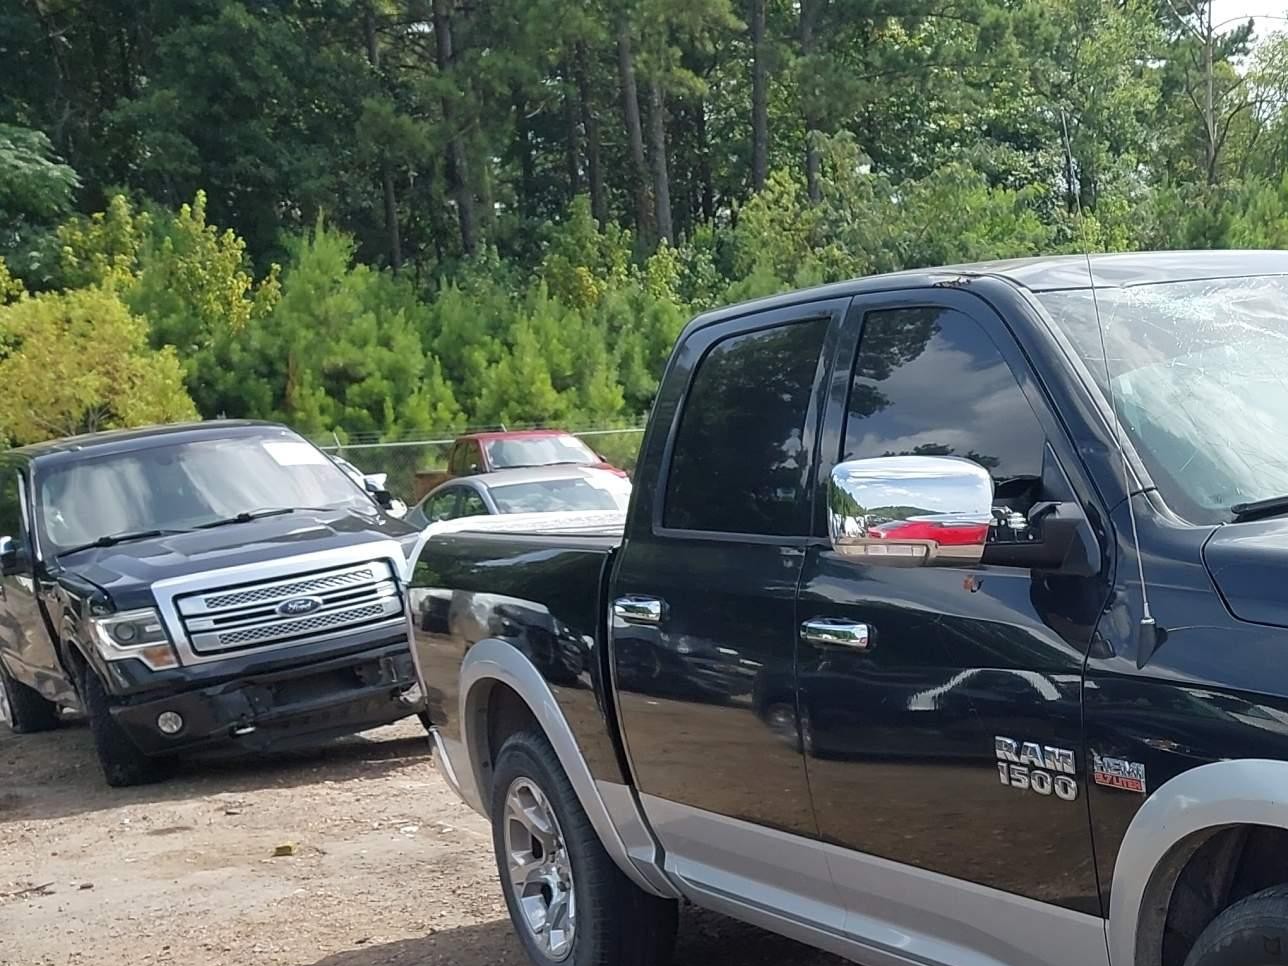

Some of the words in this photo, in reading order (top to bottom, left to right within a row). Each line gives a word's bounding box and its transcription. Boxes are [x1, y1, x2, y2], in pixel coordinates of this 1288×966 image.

[288, 600, 312, 612] Ford
[995, 735, 1076, 775] RAM
[998, 761, 1078, 801] 1500
